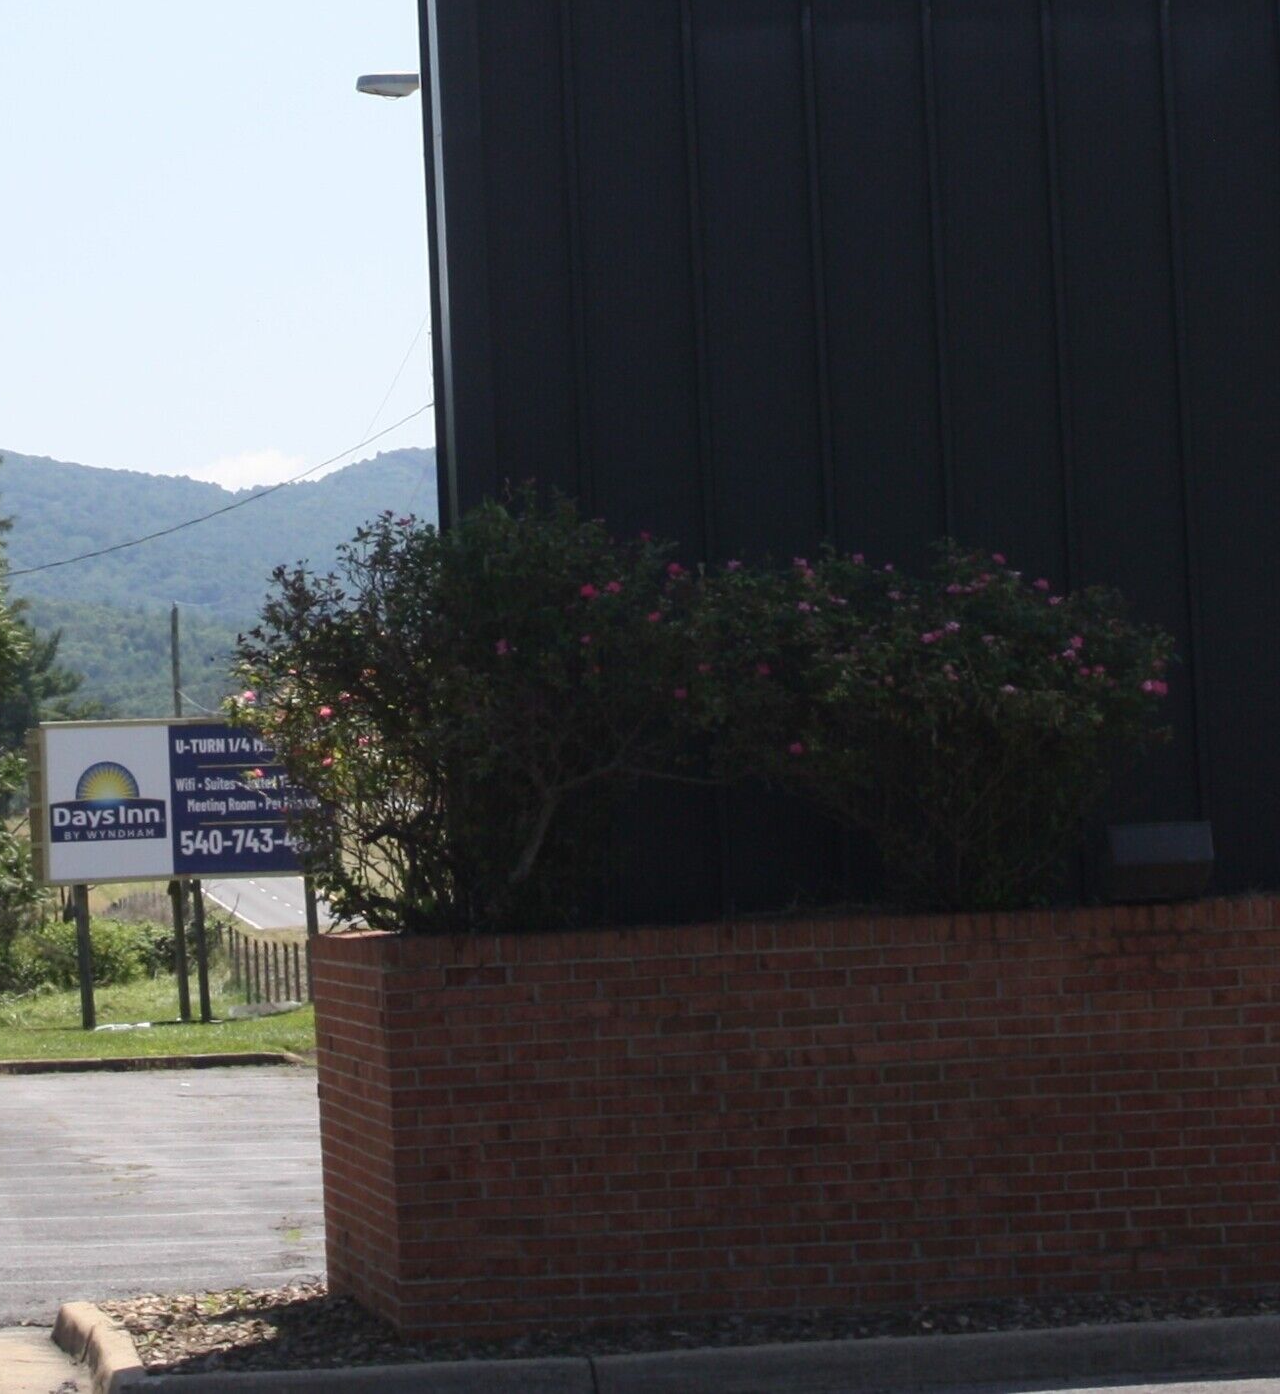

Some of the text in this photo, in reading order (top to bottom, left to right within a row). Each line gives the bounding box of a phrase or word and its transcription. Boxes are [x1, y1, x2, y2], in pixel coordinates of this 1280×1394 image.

[175, 738, 225, 754] U-TURN
[228, 737, 250, 753] 1/4
[175, 777, 196, 792] Wifi
[204, 776, 236, 791] Suites
[187, 798, 227, 815] Meeting
[228, 797, 257, 811] Room
[53, 806, 160, 828] Days Inn
[64, 828, 154, 840] BY WYNDHAM
